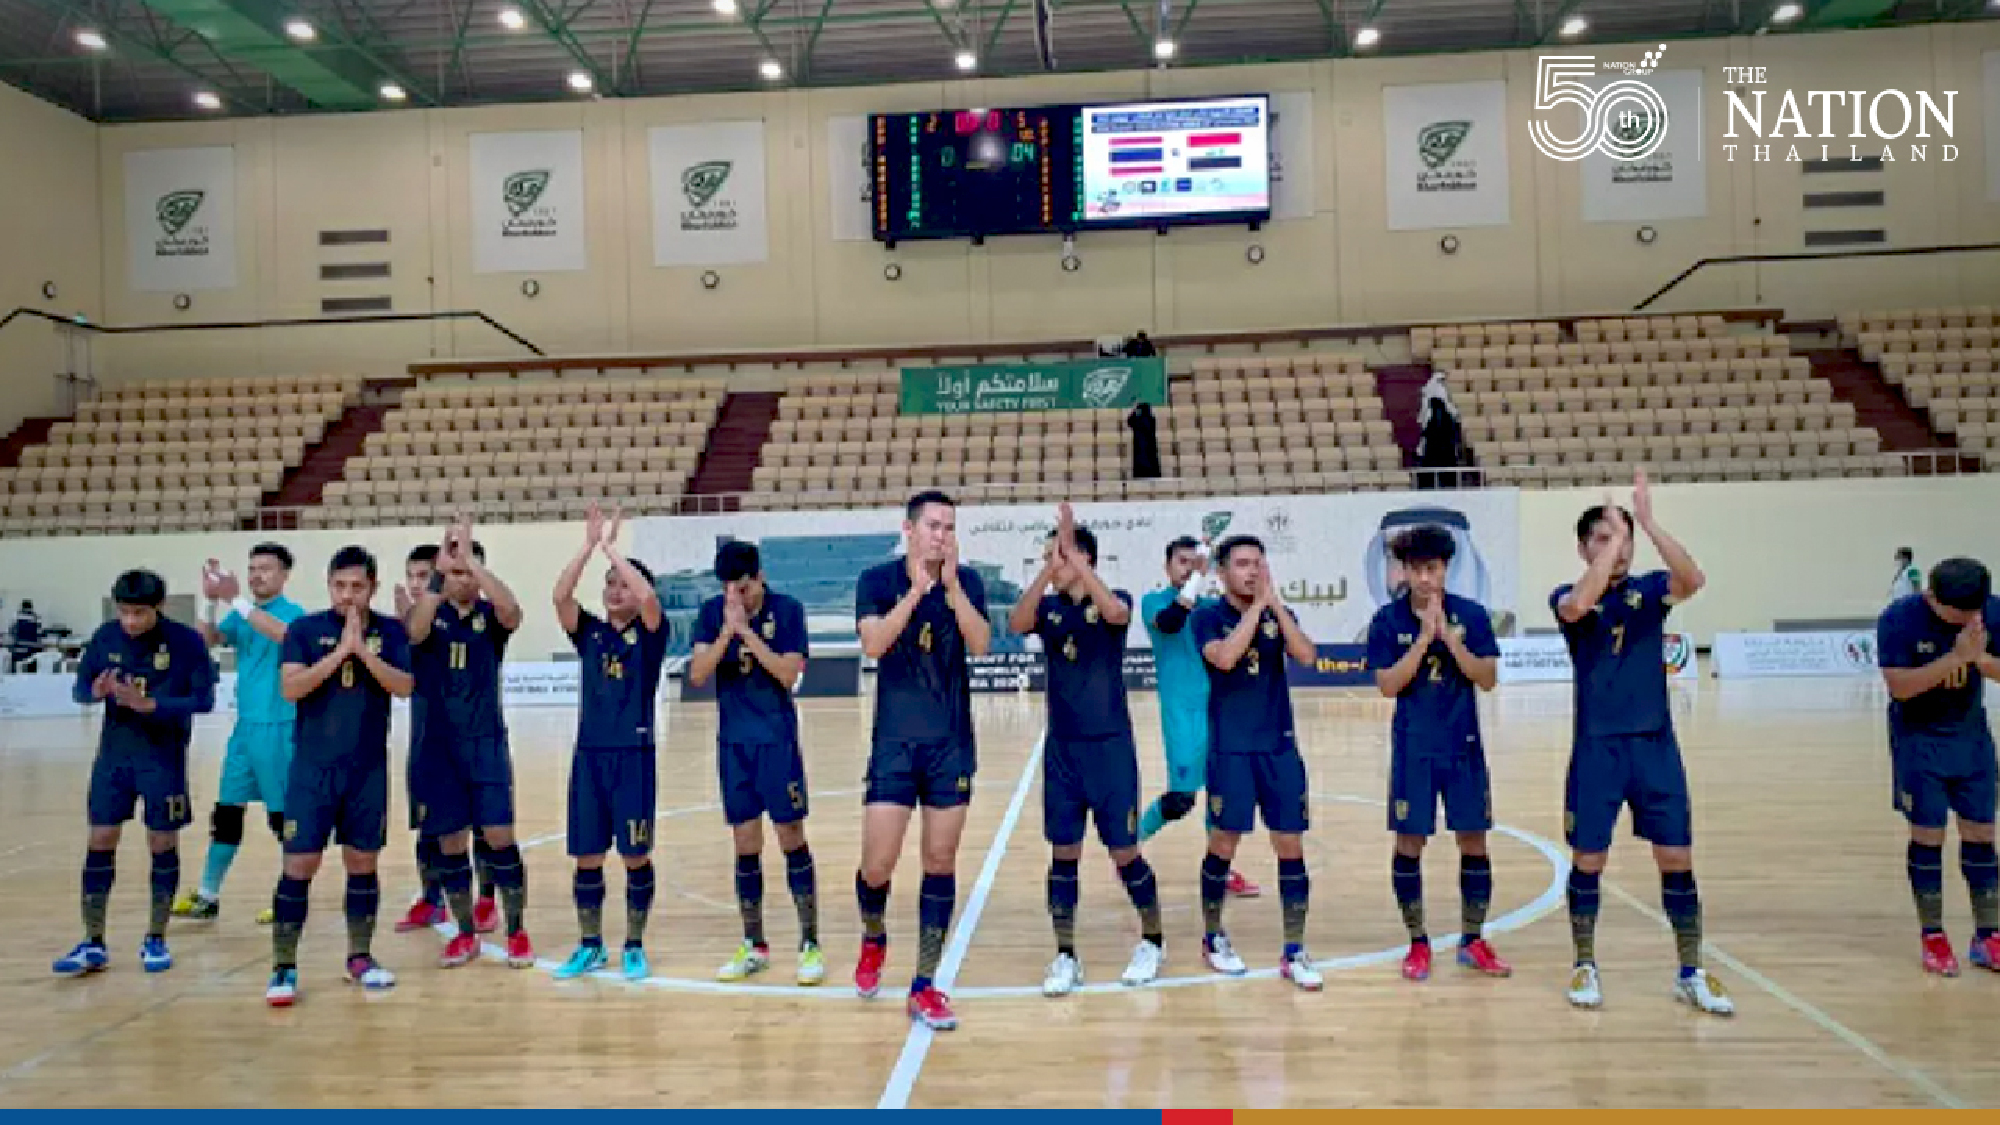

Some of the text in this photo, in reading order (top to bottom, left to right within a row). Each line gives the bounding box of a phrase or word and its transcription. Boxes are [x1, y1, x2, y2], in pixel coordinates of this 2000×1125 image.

[1280, 577, 1348, 608] لبيك
[1611, 624, 1626, 655] 7
[449, 641, 467, 670] 11
[738, 644, 753, 674] 5
[1427, 655, 1442, 681] 2
[787, 780, 804, 810] 5
